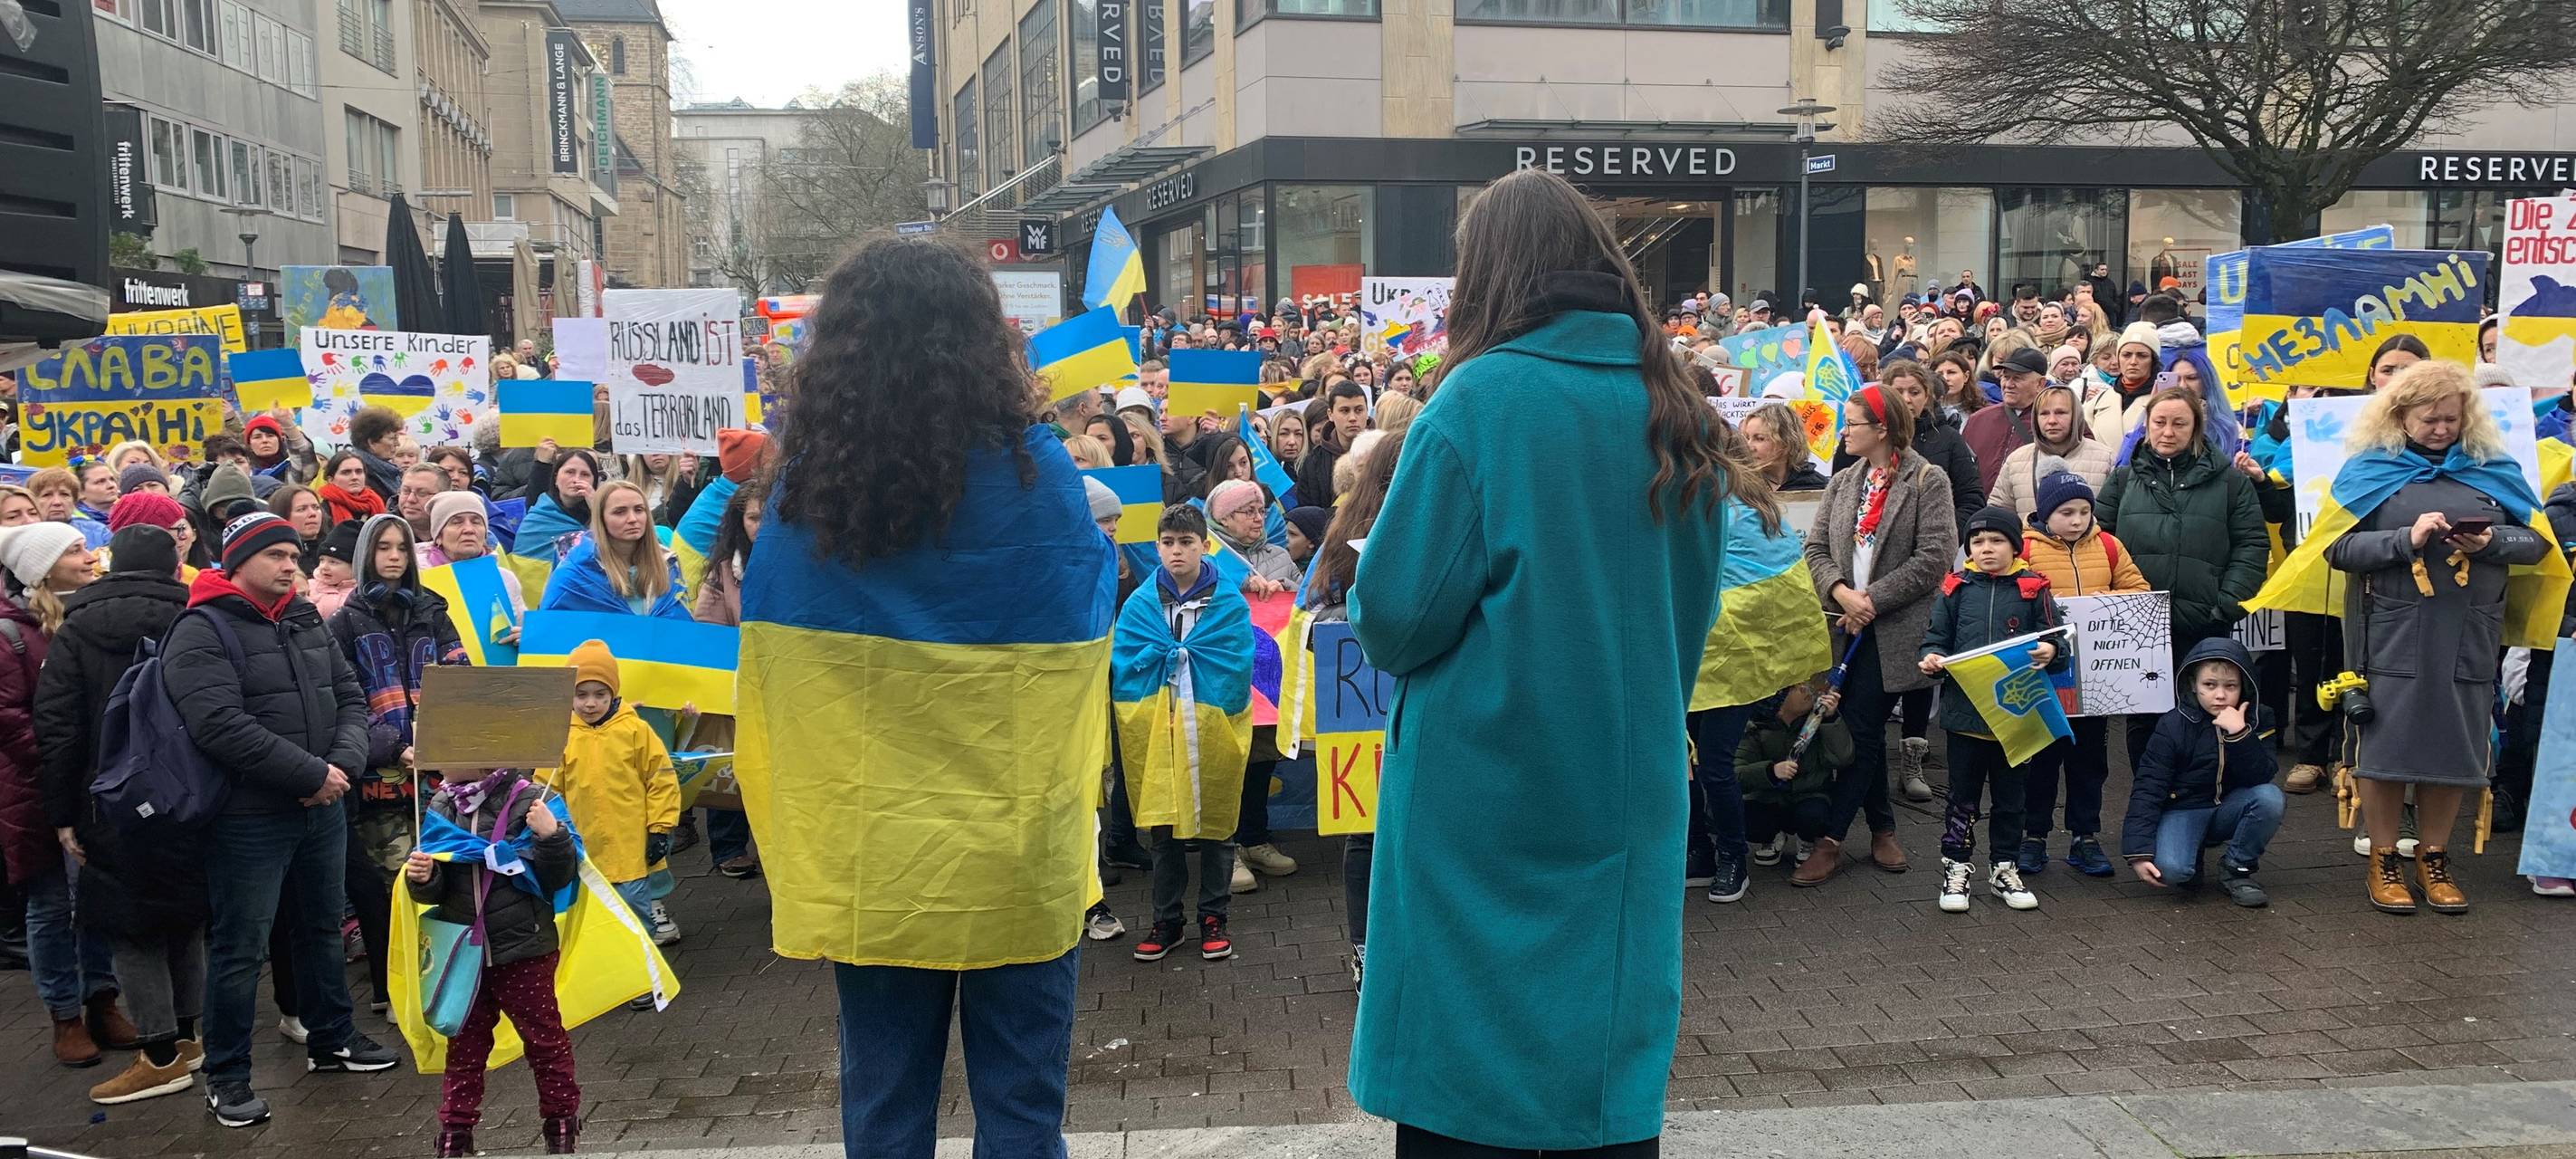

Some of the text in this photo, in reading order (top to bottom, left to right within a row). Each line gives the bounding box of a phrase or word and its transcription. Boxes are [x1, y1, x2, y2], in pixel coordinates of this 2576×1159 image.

[913, 7, 927, 65] ANSON'S
[555, 43, 569, 162] BRINCKMANN & LANGE
[595, 76, 609, 167] DEICHMANN
[117, 140, 136, 219] frittenwerk
[1516, 147, 1736, 175] RESERVED
[1810, 159, 1831, 170] Markt
[2421, 156, 2576, 181] RESERVE
[1146, 172, 1193, 211] RESERVED
[2510, 198, 2553, 231] Die
[124, 277, 189, 307] frittenwerk
[1302, 293, 1352, 309] SLE
[609, 321, 701, 362] RUSSLAND
[25, 343, 214, 392] СЛАВА
[615, 393, 731, 440] das TERRORLAND
[2094, 638, 2128, 651] NICHT
